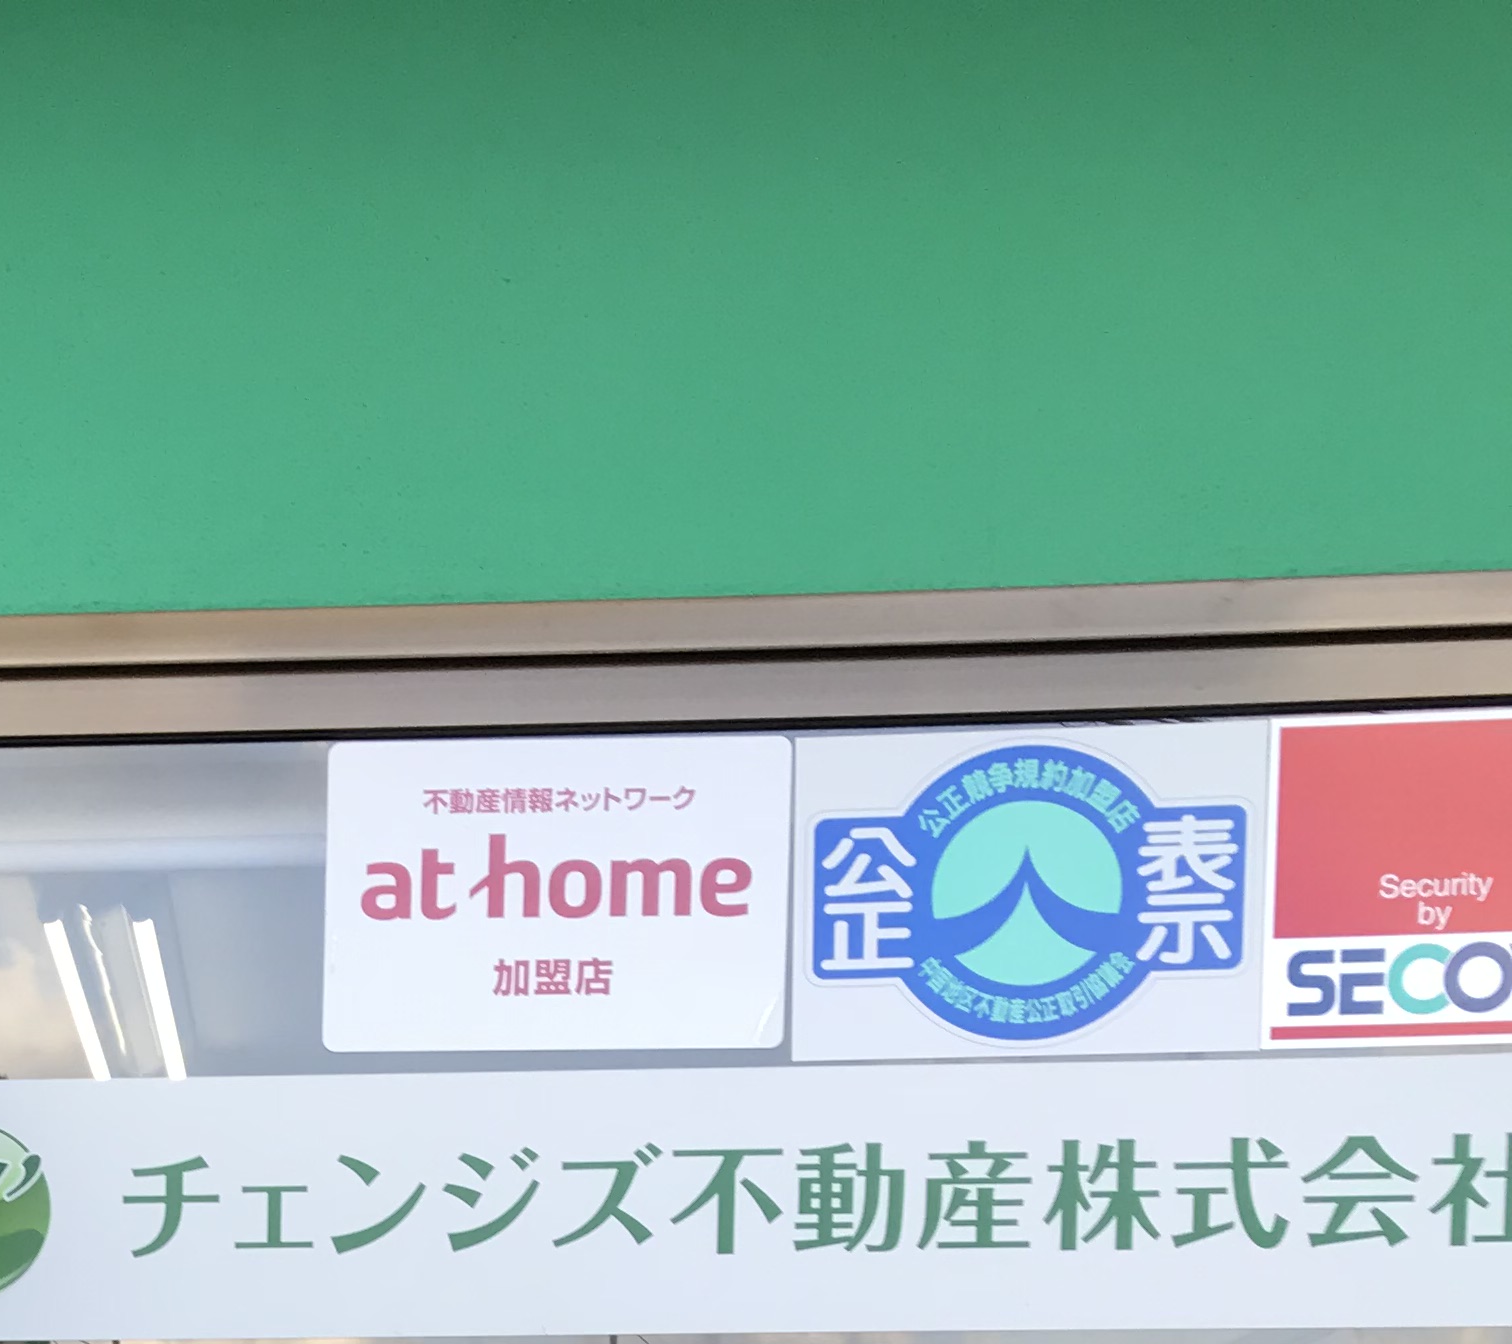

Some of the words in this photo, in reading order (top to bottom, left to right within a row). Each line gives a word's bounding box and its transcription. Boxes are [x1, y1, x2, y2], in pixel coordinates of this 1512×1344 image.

[422, 786, 696, 815] 不動産情報ネットワーク
[821, 826, 917, 972] 公正
[1136, 814, 1239, 965] 表示
[1378, 872, 1494, 901] Security
[1417, 901, 1453, 930] by
[492, 958, 614, 997] 加盟店
[1286, 941, 1512, 1017] SECO
[122, 1132, 1512, 1258] チェンジズ不動産株式会社
